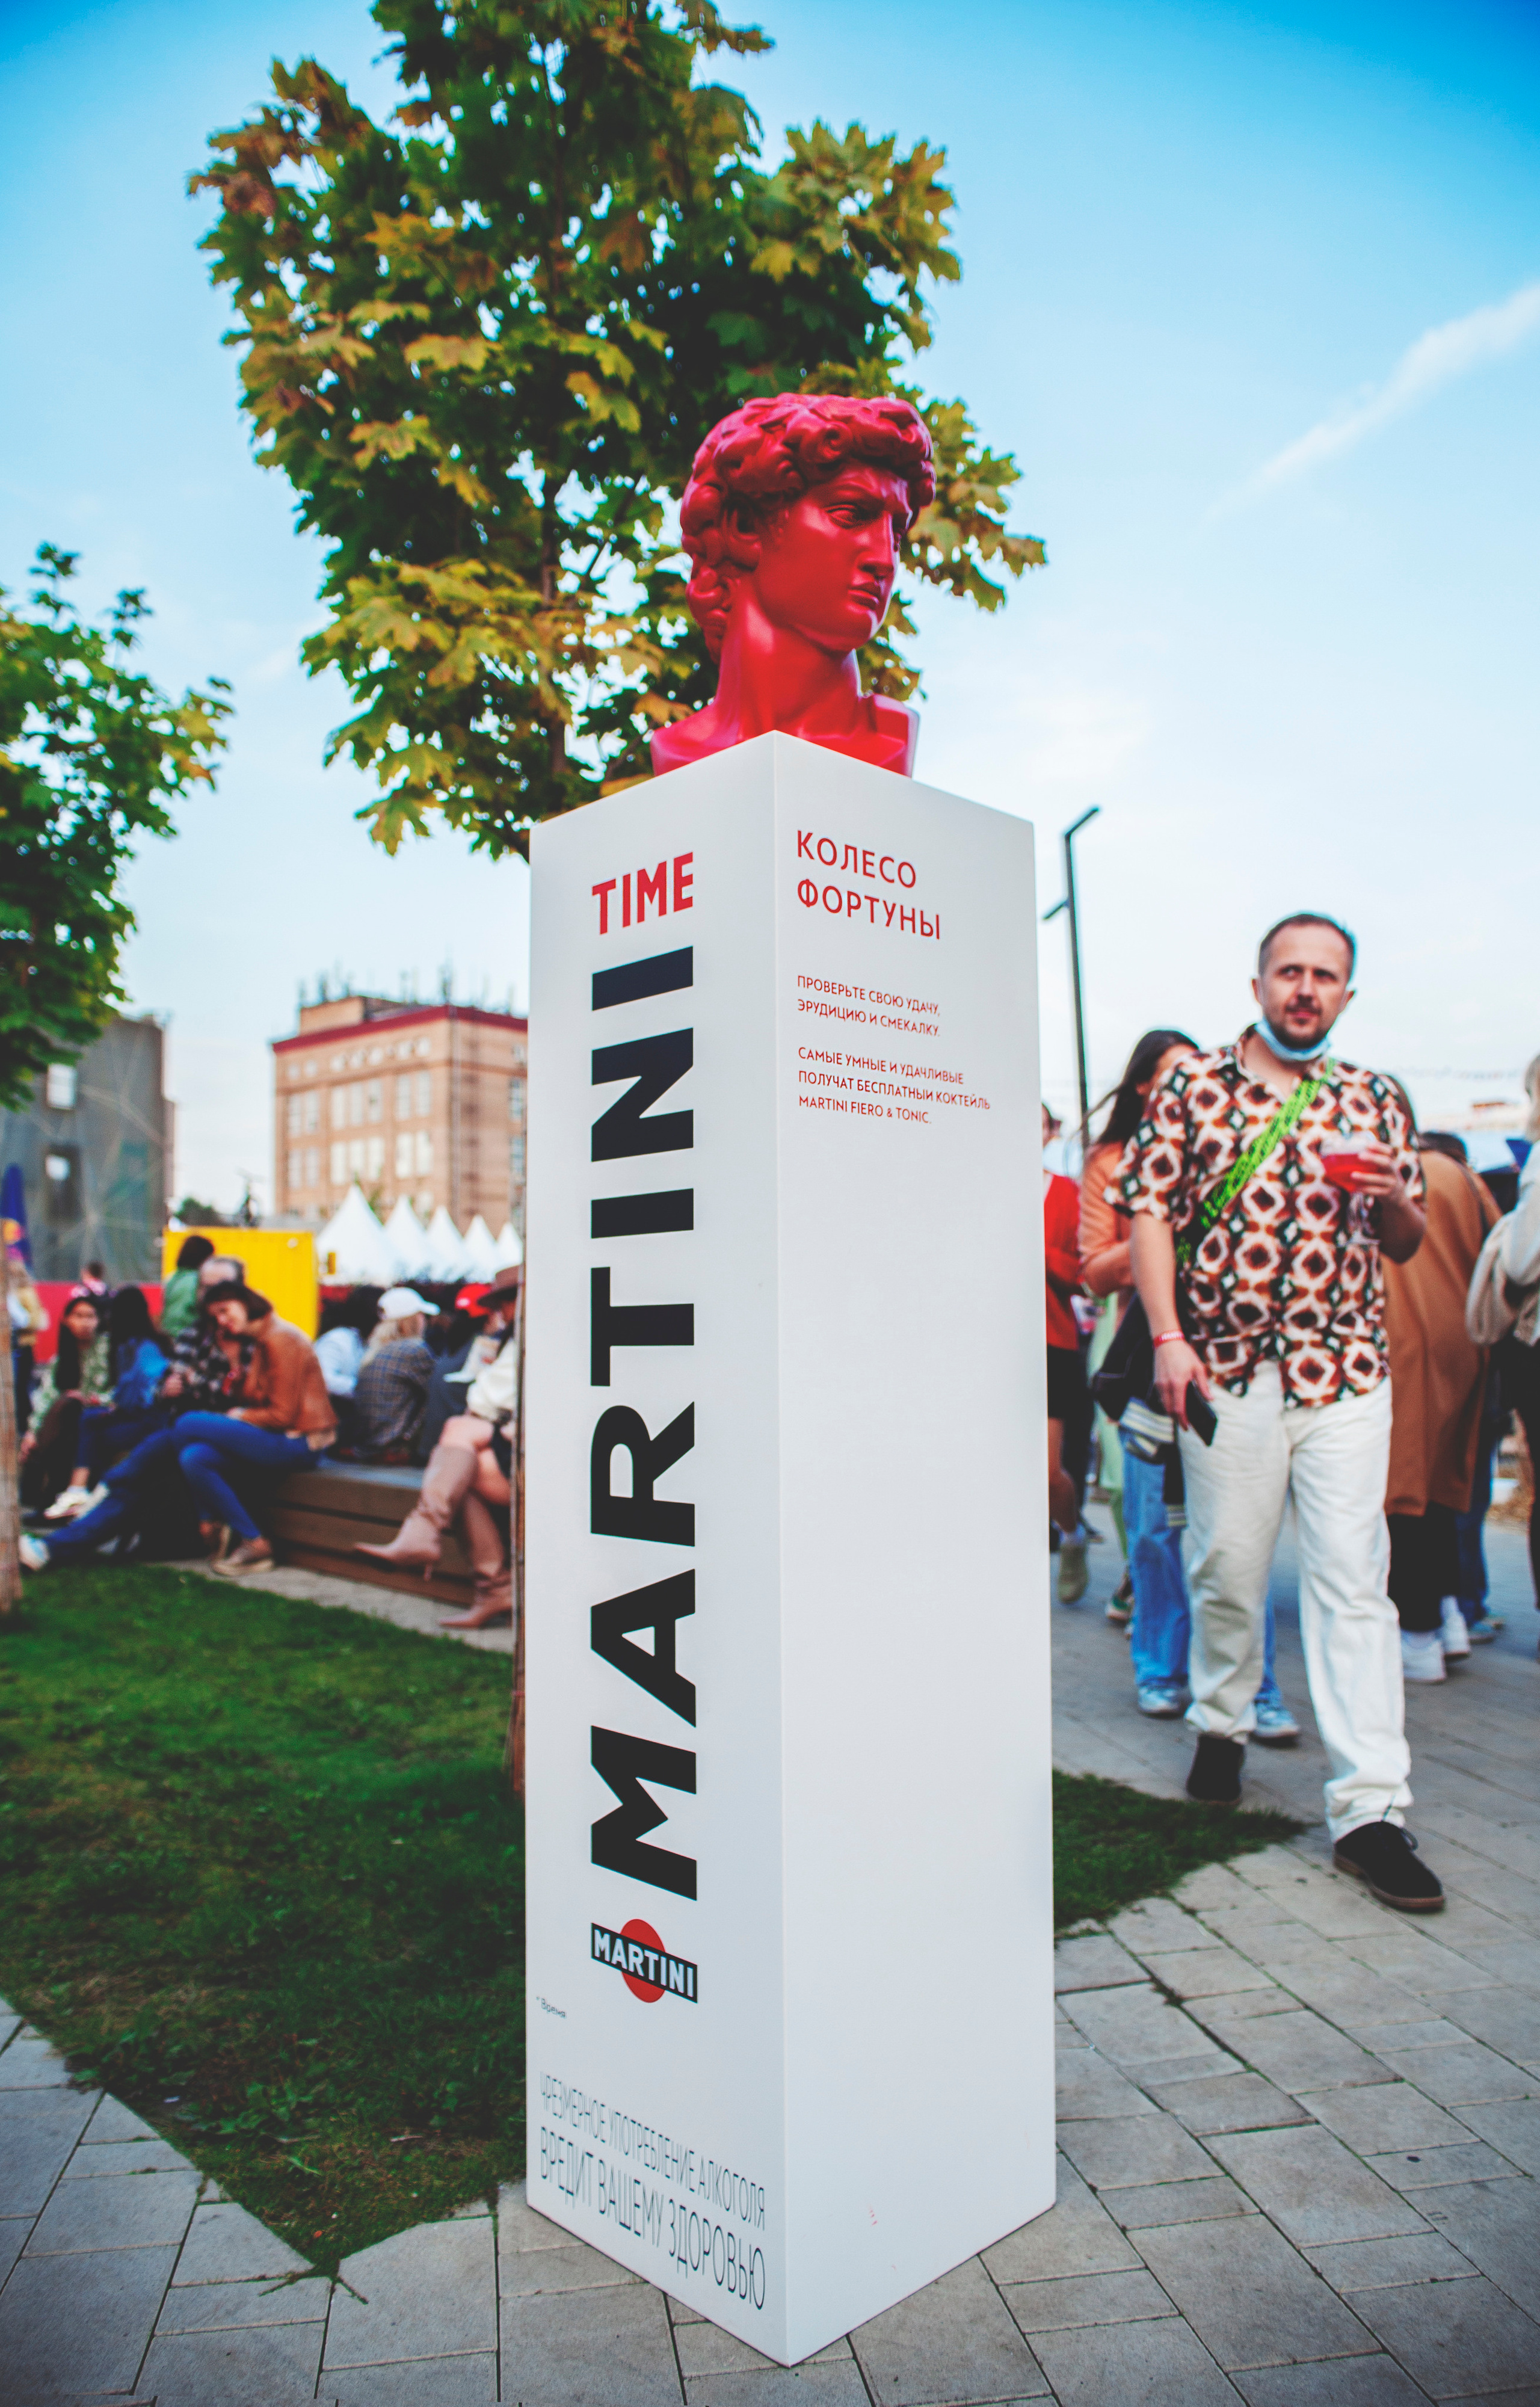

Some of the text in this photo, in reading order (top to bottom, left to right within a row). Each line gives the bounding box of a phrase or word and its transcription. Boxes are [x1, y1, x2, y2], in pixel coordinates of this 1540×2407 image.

[797, 830, 916, 889] КОЛЕСО
[592, 852, 693, 935] TIME
[797, 878, 940, 940] ФОРТУНЫ
[798, 975, 940, 1017] ПРОВЕРЬТЕ СВОЮ УДАЧУ,
[798, 999, 940, 1037] ЭРУДИЦИЮ И СМЕКАЛКУ.
[798, 1047, 964, 1084] САМЫЕ УМНЫЕ И УДАЧЛИВЫЕ
[799, 1070, 854, 1089] ПОЛУЧАТ
[936, 1091, 990, 1109] КОКТЕЙЛЬ
[799, 1096, 932, 1124] MARTINI FIERO & TONIC.
[591, 946, 698, 1901] MARTINI
[594, 1929, 694, 1997] MARTINI
[540, 2071, 765, 2231] ЧРЕЗМЕРНОЕ УПОТРЕБЛЕНИЕ АЛКОГОЛЯ
[541, 2126, 765, 2310] ВРЕДИТ ВАШЕМУ ЗДОРОВЬЮ
